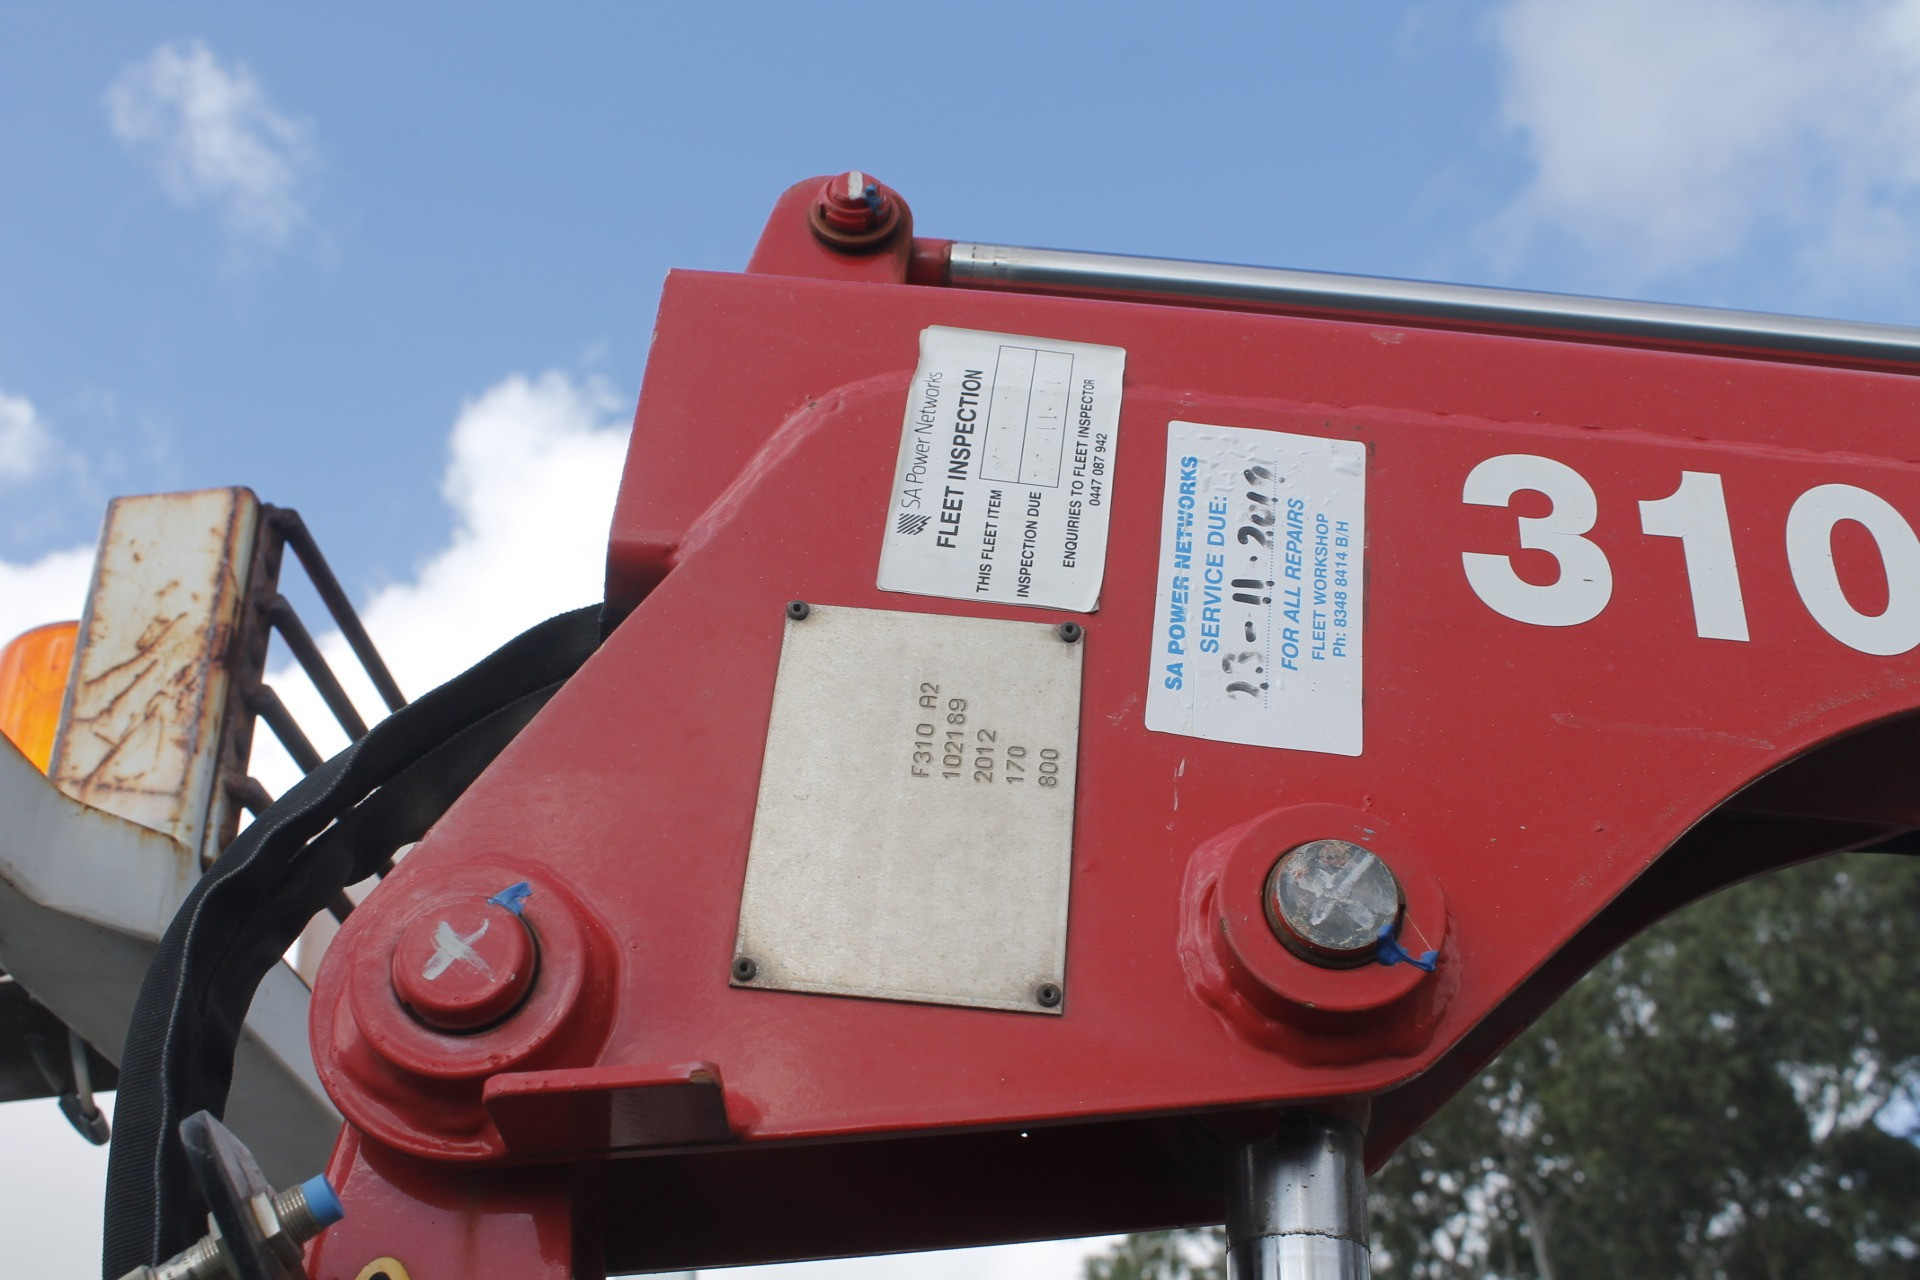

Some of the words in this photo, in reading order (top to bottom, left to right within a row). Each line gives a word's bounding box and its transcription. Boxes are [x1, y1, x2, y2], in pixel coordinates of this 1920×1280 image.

[915, 372, 943, 434] Networks
[948, 369, 983, 480] INSPECTION
[1078, 379, 1095, 438] INSPECTOR
[906, 436, 930, 483] Power
[1073, 441, 1087, 477] FLEET
[1095, 433, 1107, 454] 942
[1071, 479, 1084, 497] TO
[1092, 456, 1105, 476] 087
[902, 487, 920, 509] SA
[987, 489, 1002, 519] ITEM
[1089, 477, 1102, 506] 0447
[1174, 455, 1198, 570] NETWORKS
[937, 486, 964, 548] FLEET
[1063, 501, 1082, 568] ENQUIRIES
[1208, 495, 1227, 546] DUE:
[1285, 498, 1304, 580] REPAIRS
[1335, 521, 1350, 548] B/H
[981, 522, 997, 560] FLEET
[1017, 520, 1037, 598] INSPECTION
[1027, 491, 1041, 518] DUE
[1314, 513, 1329, 607] WORKSHOP
[1462, 454, 1920, 656] 310
[977, 563, 992, 593] THIS
[1335, 551, 1348, 587] 8414
[1167, 576, 1189, 655] POWER
[1200, 553, 1224, 654] SERVICE
[1283, 587, 1300, 624] ALL
[1334, 589, 1347, 628] 8348
[1281, 628, 1298, 672] FOR
[1311, 610, 1326, 660] FLEET
[1333, 631, 1346, 658] Ph:
[919, 682, 939, 708] A2
[1164, 662, 1183, 691] SA
[911, 723, 935, 778] F310
[942, 698, 967, 778] 102189
[973, 729, 996, 783] 2012
[1006, 745, 1026, 784] 170
[1038, 748, 1058, 787] 800
